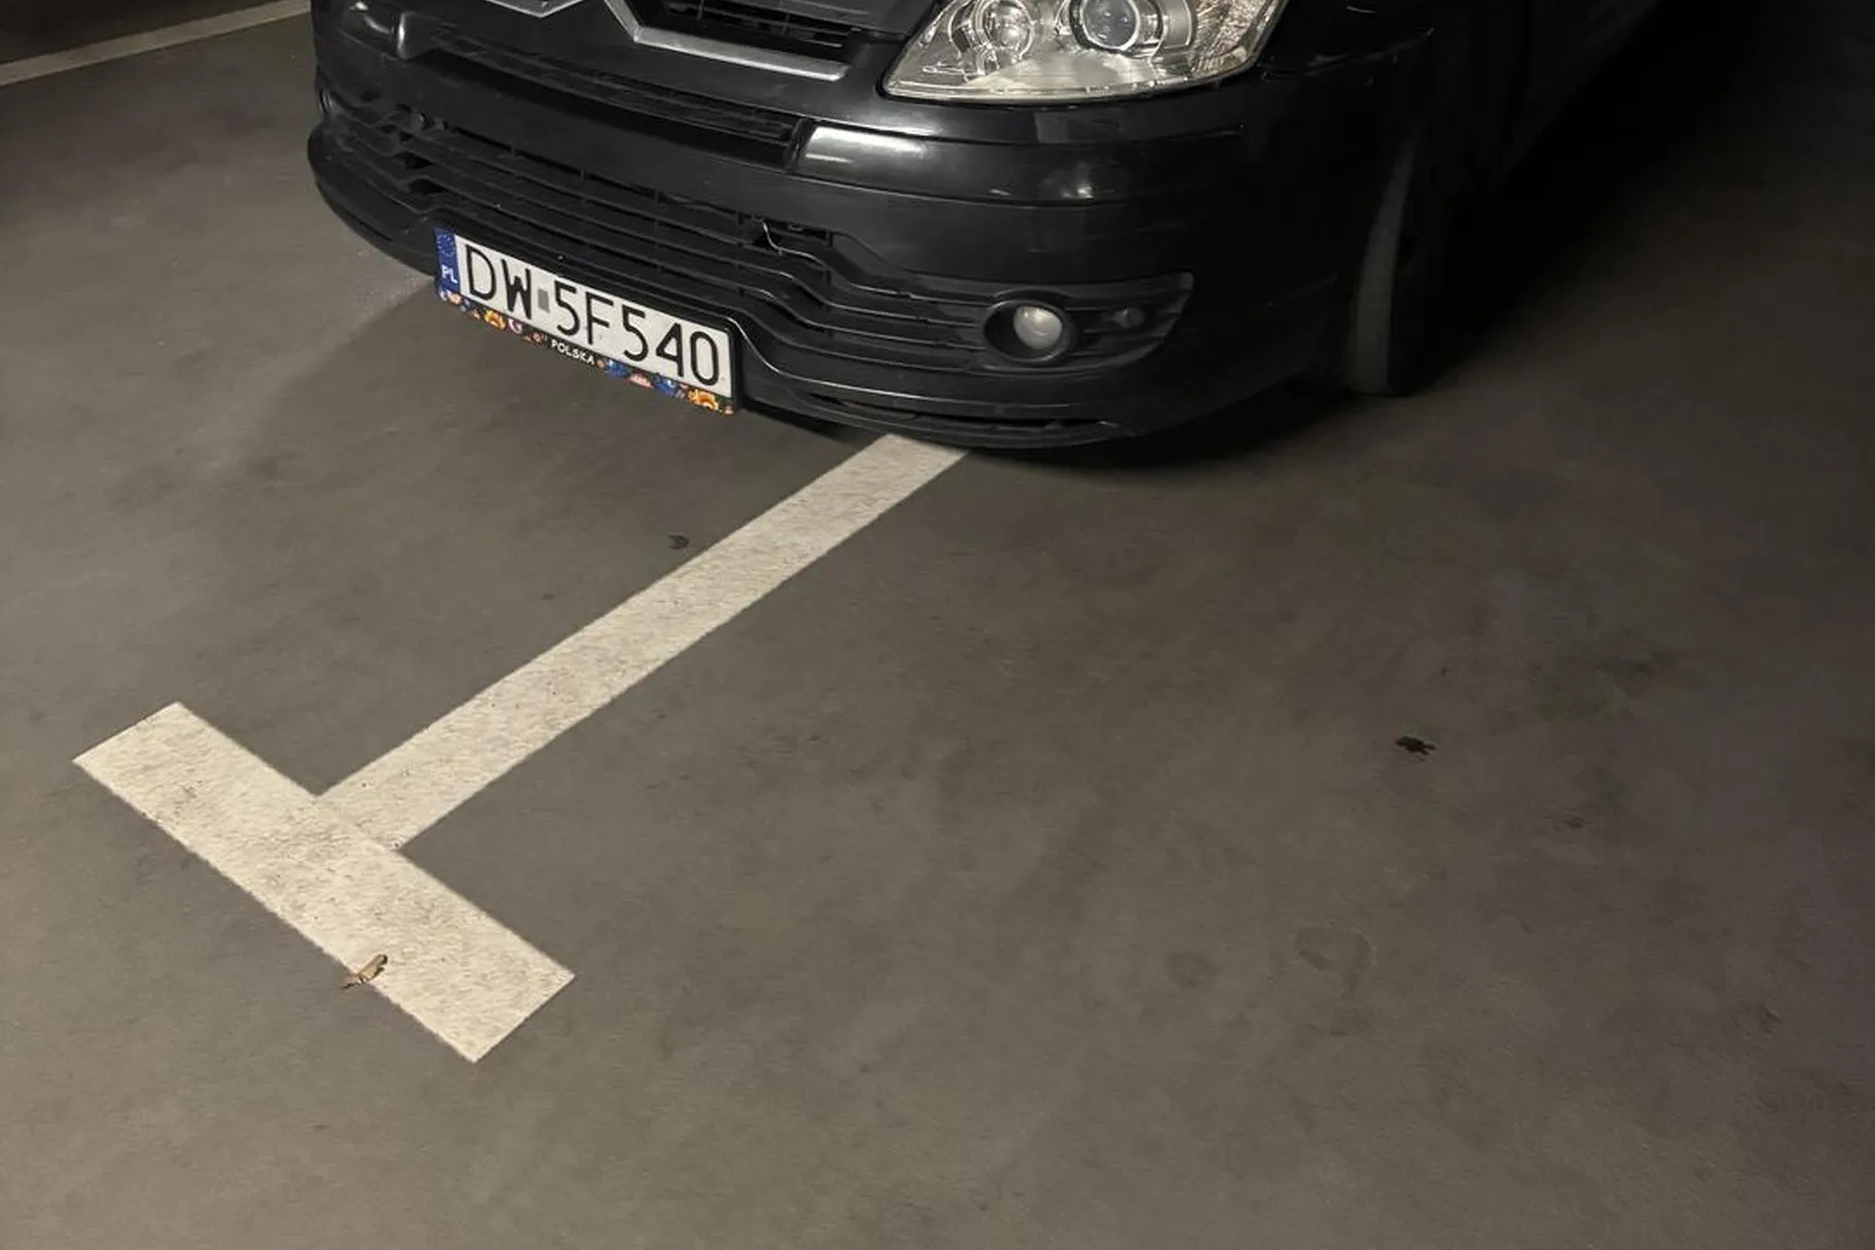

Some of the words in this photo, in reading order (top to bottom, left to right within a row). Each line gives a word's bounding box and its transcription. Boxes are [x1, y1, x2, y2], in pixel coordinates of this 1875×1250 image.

[441, 263, 459, 284] PL
[464, 244, 532, 320] DW
[554, 280, 719, 387] 5F540
[551, 339, 595, 366] POLSKA
